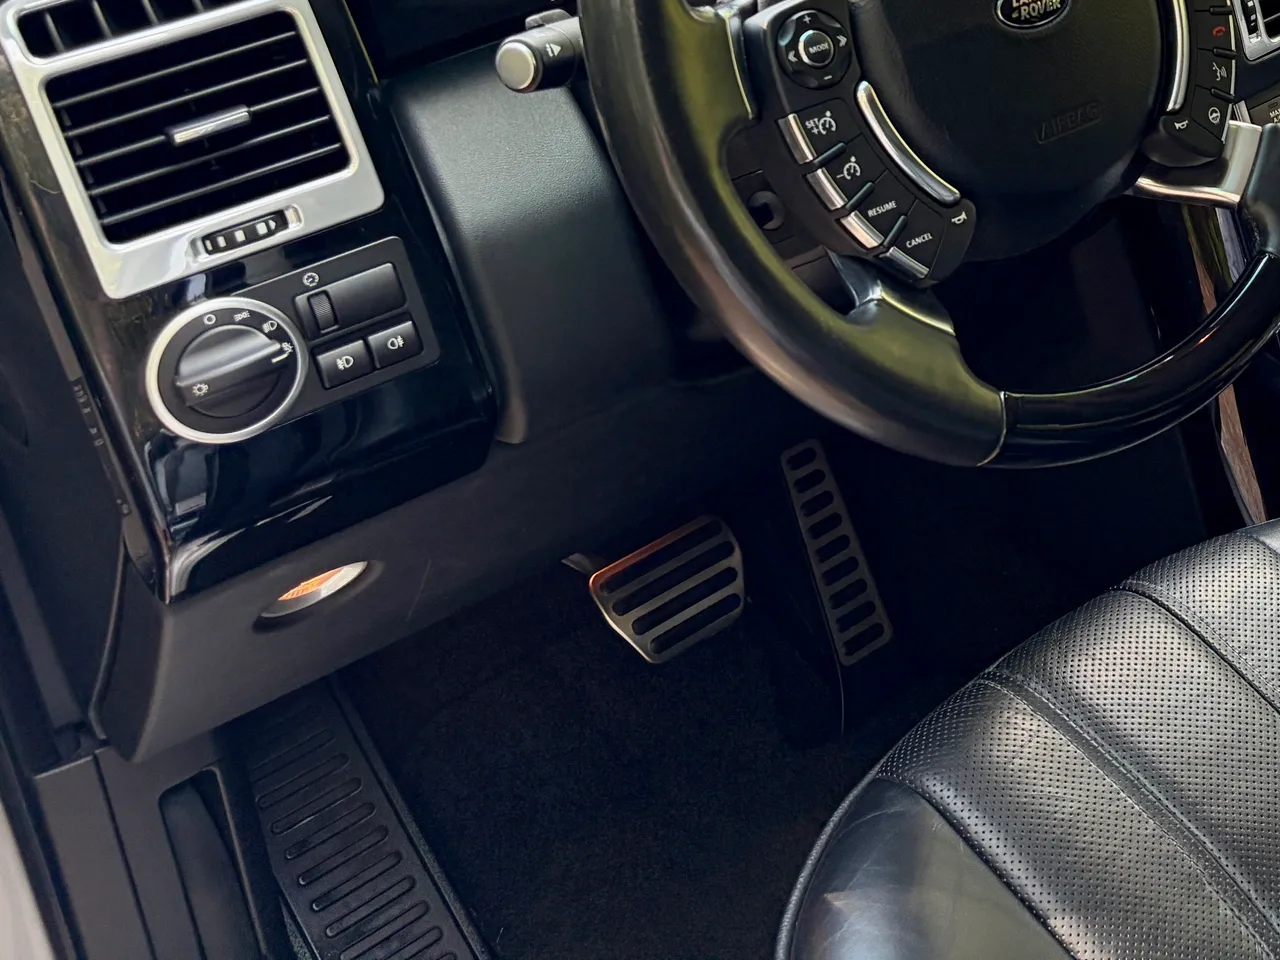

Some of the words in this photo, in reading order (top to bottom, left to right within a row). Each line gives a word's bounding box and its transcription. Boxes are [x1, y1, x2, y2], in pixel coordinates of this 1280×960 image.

[805, 118, 820, 129] SET
[867, 200, 897, 217] RESUME
[905, 232, 933, 248] CANCEL
